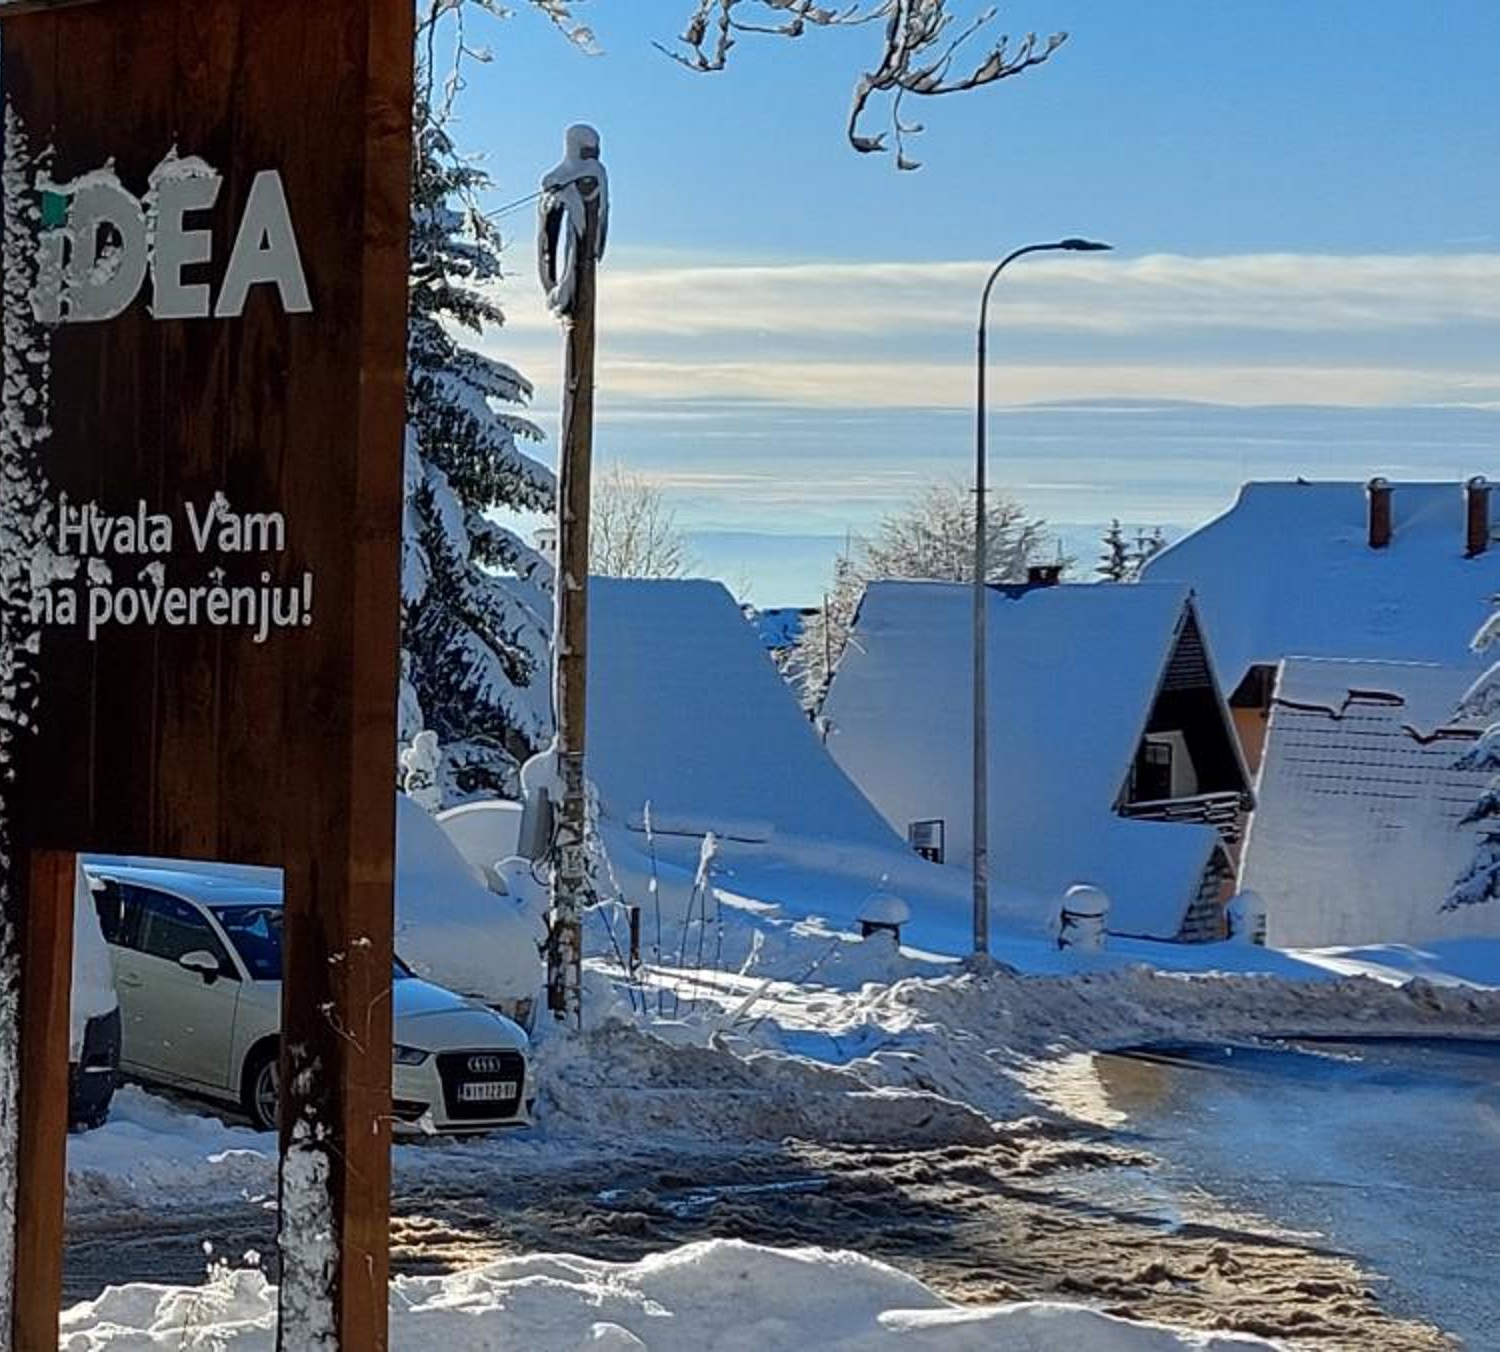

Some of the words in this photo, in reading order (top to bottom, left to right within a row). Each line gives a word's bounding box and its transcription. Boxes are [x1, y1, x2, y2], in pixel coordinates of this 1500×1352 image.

[58, 500, 173, 555] Hvala
[185, 501, 286, 553] Vam
[31, 585, 77, 625] na
[87, 571, 313, 643] poverenju!
